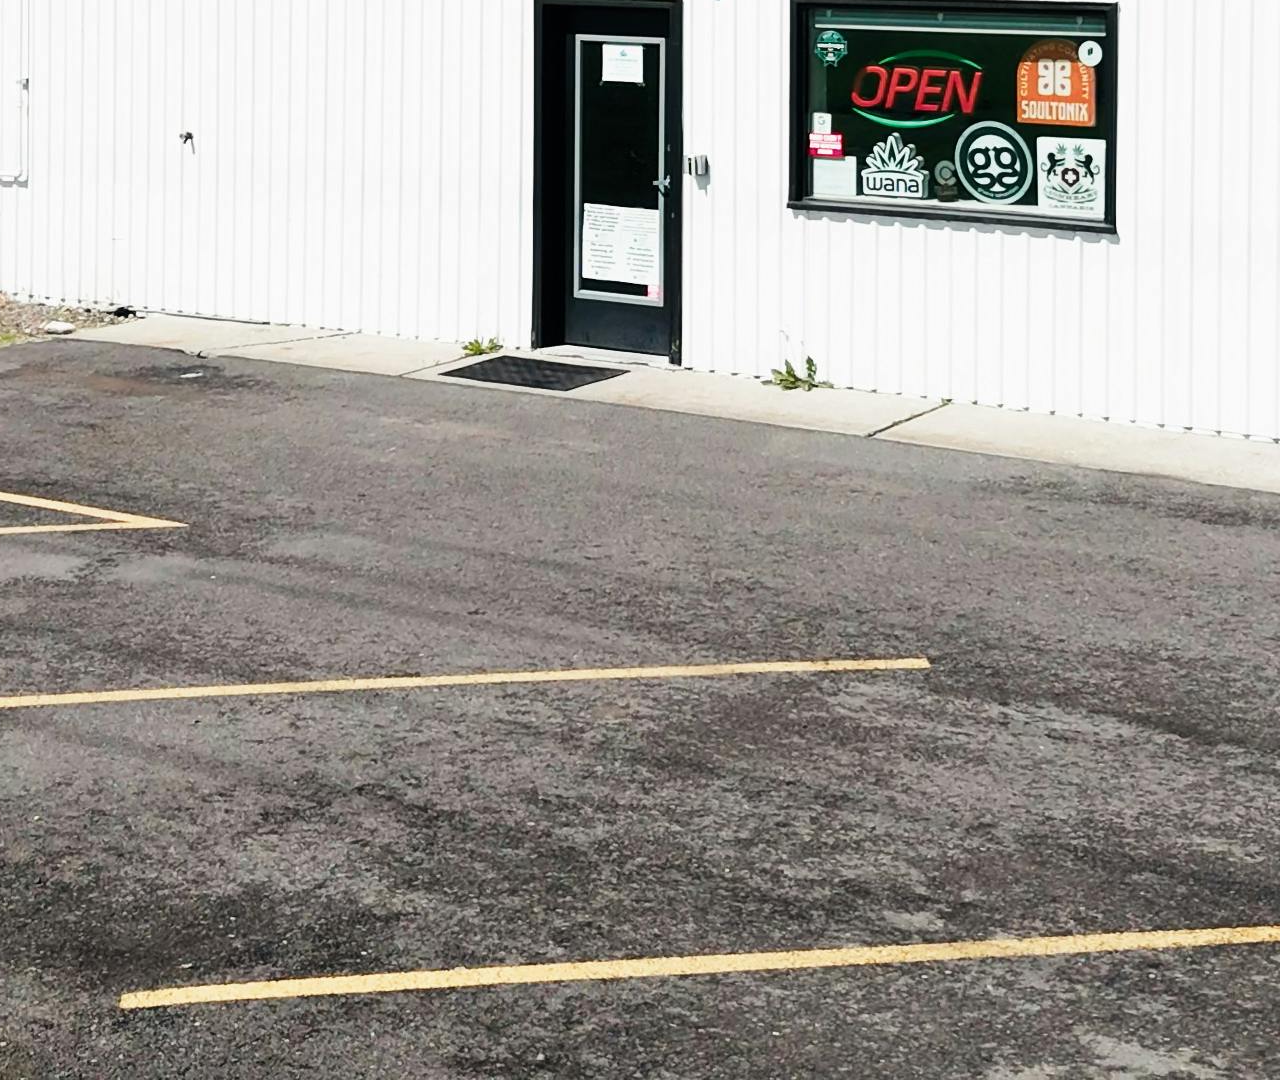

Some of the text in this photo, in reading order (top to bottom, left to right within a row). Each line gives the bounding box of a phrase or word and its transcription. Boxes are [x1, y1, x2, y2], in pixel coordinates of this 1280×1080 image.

[851, 65, 983, 114] OPEN
[1021, 100, 1089, 122] SOULTONIX
[866, 176, 920, 194] wana
